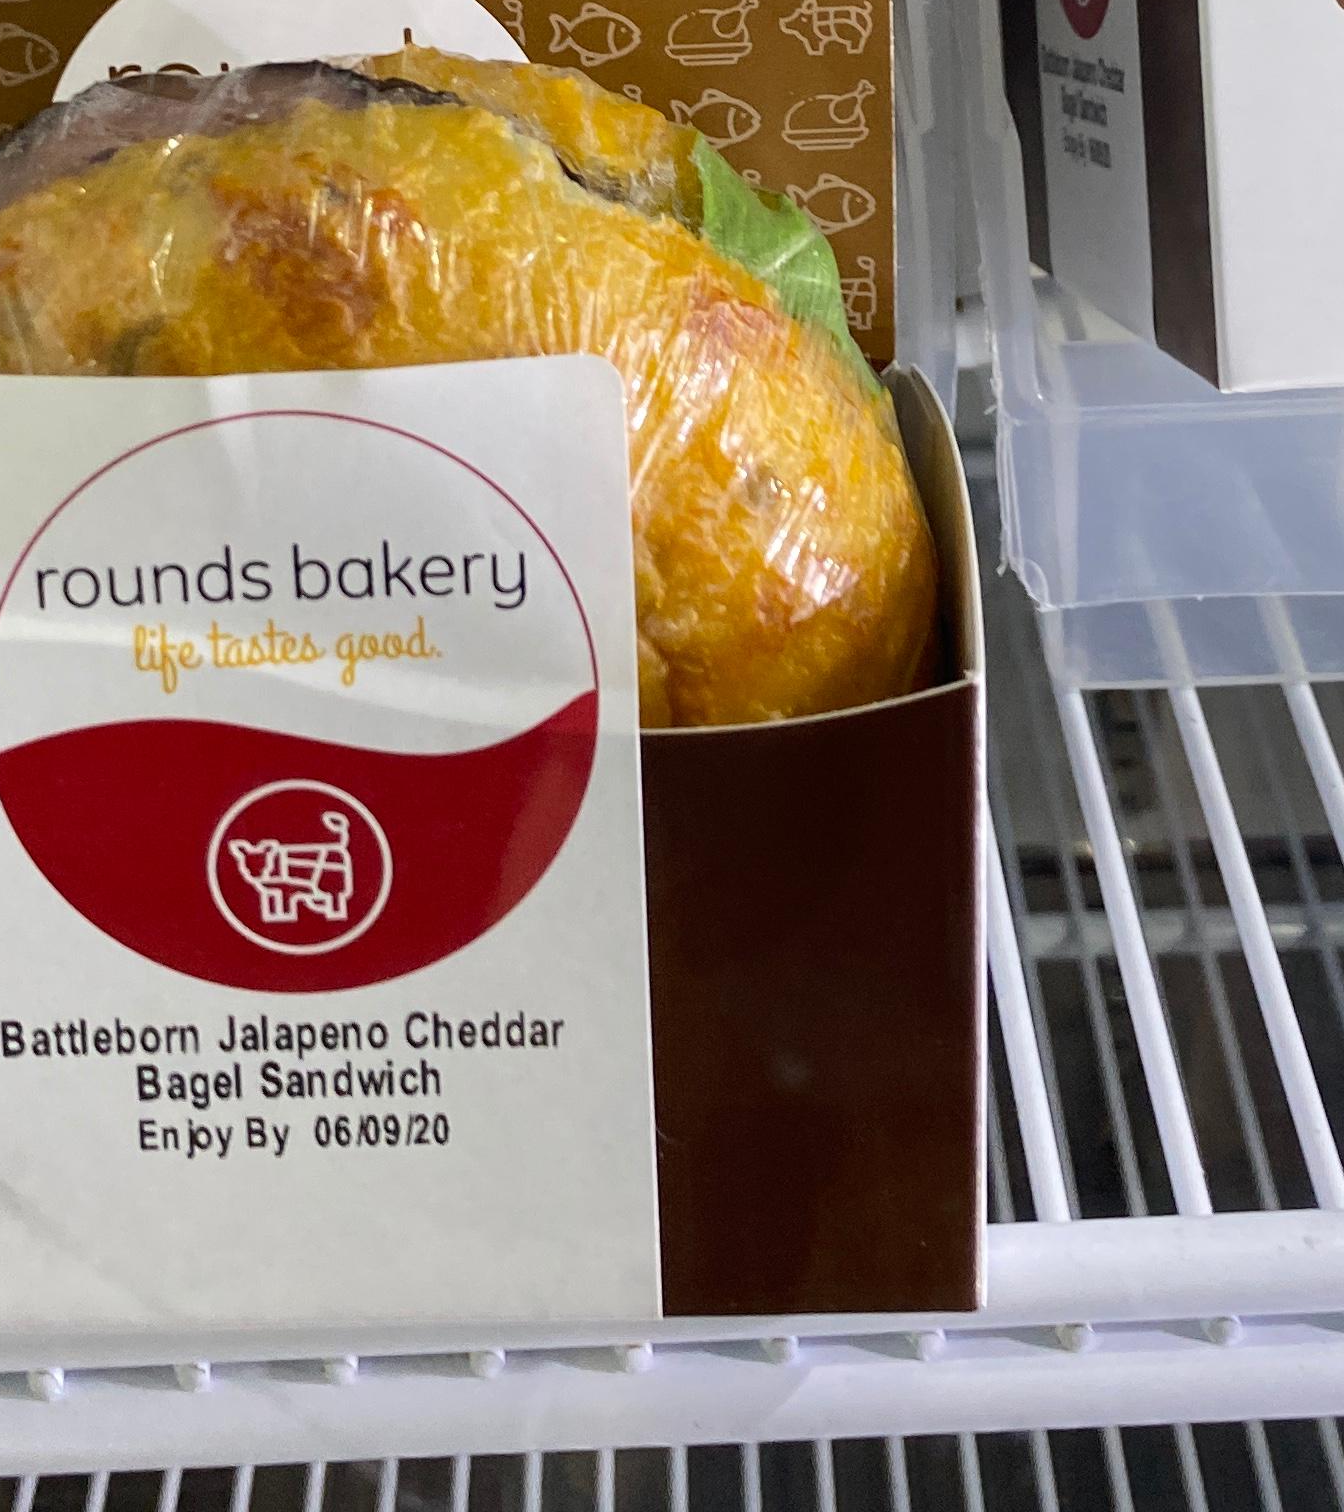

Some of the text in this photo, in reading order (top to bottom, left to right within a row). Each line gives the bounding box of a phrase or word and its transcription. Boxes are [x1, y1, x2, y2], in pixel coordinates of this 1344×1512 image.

[35, 539, 529, 610] rounds bakery
[132, 615, 444, 694] life tastes good.
[0, 1010, 565, 1061] Battleborn Jalapeno Cheddar
[136, 1060, 443, 1111] Bagel Sandwich
[137, 1113, 450, 1159] Enjoy By 06/09/20
